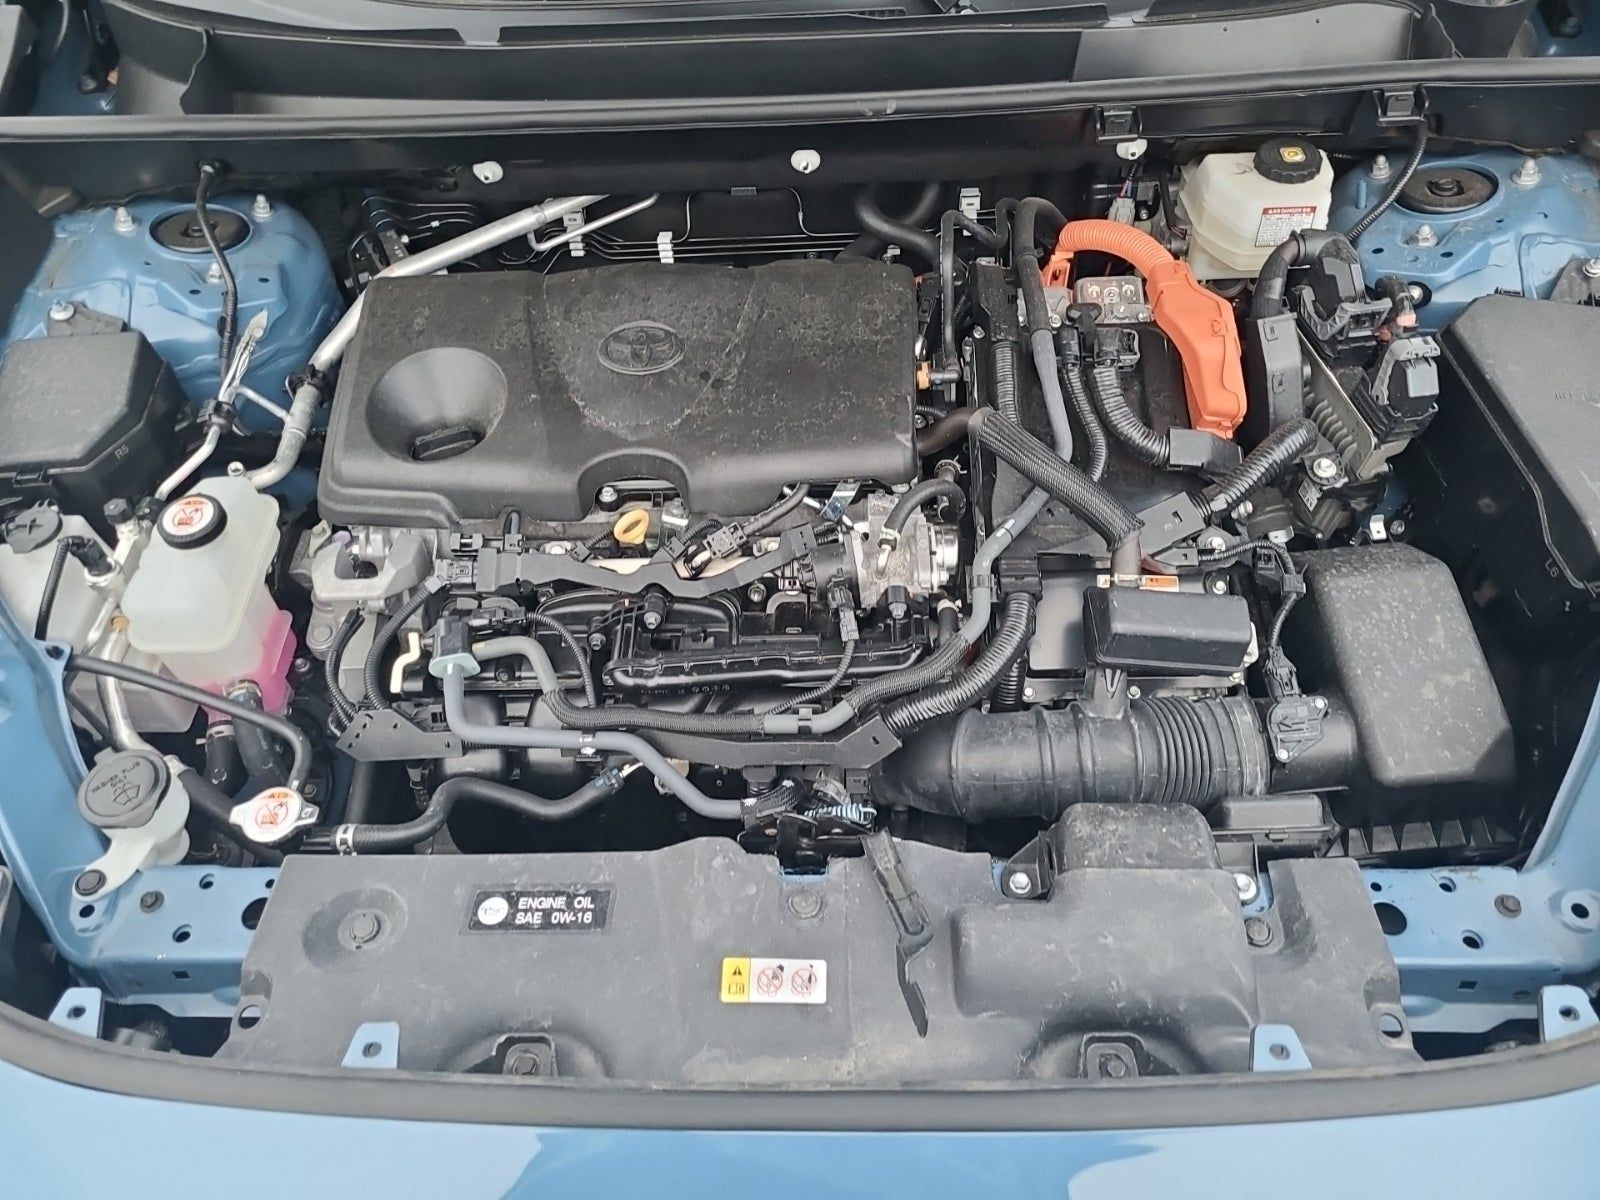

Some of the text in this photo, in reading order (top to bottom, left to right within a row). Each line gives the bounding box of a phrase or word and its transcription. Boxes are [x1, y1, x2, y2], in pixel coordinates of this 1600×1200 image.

[517, 896, 567, 910] ENGINE
[573, 896, 595, 909] OIL
[515, 911, 593, 925] SAE 0W-16
